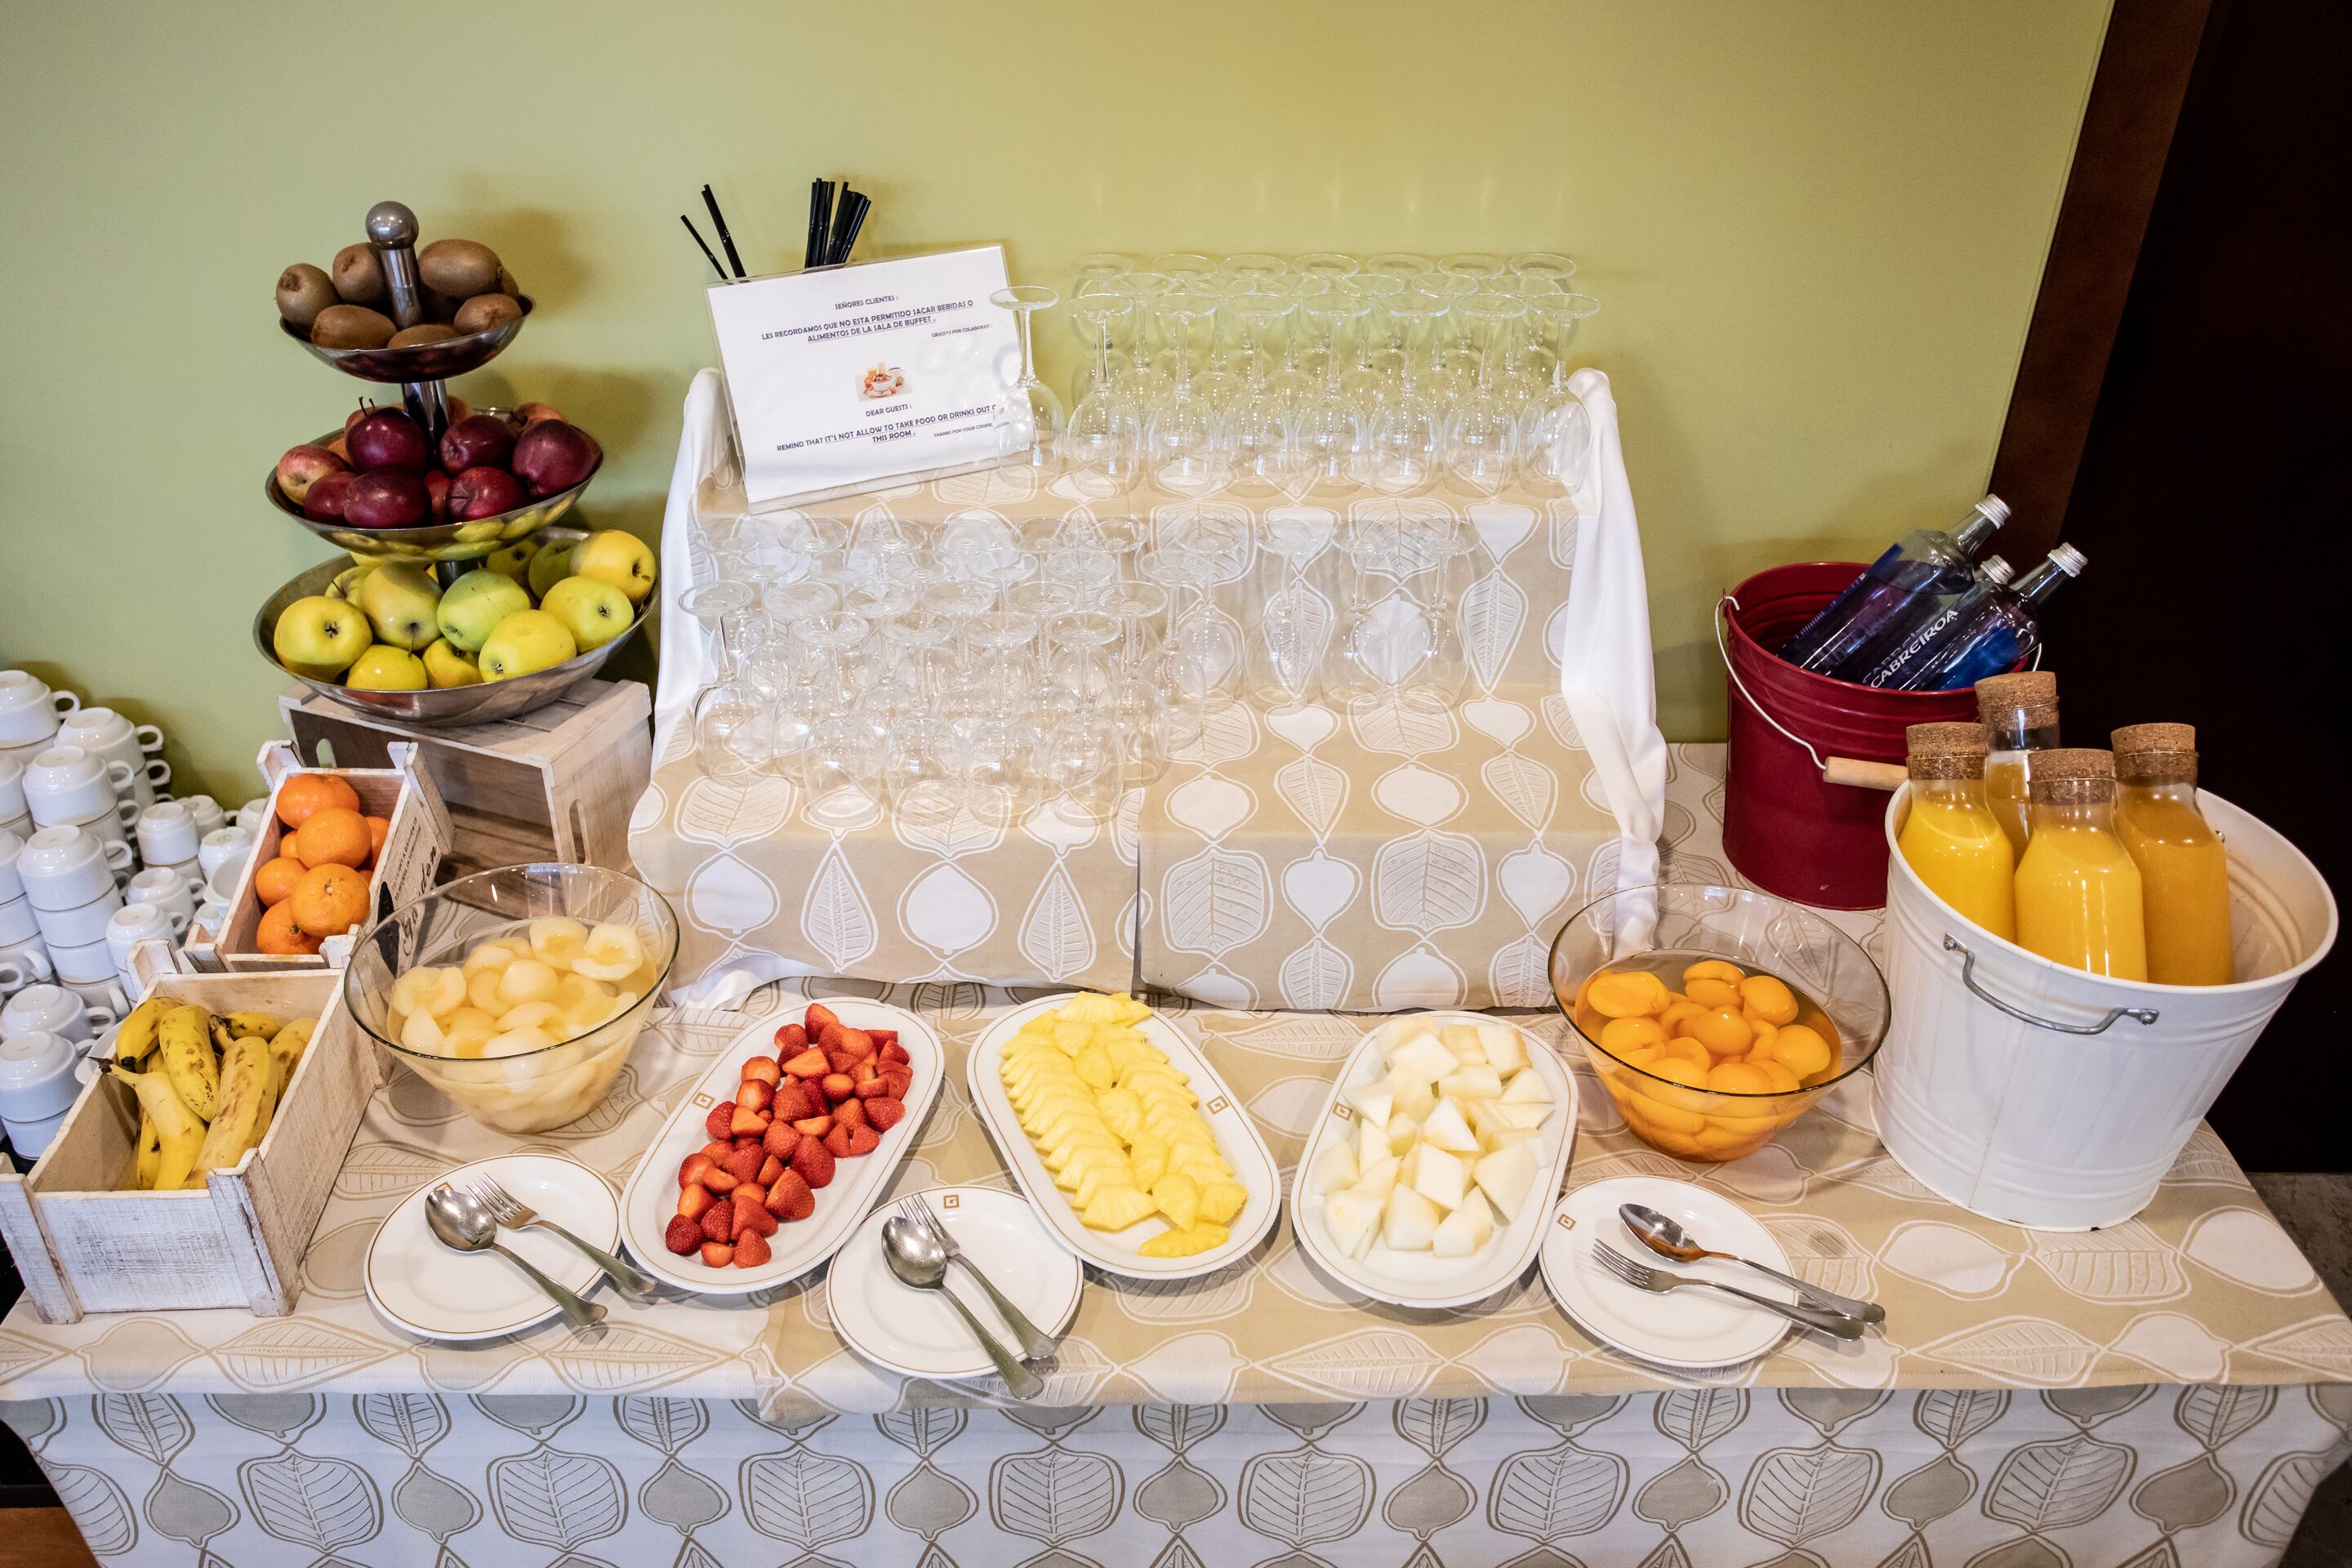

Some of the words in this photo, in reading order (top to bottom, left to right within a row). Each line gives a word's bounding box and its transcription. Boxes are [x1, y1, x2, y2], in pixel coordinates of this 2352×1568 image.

[835, 300, 864, 310] SEÑORES
[865, 295, 895, 305] CLIENTES
[761, 332, 773, 341] LES
[774, 325, 822, 338] RECORDAMOS
[823, 322, 838, 330] QUE
[839, 319, 851, 327] NO
[852, 316, 870, 325] ESTA
[871, 310, 911, 323] PERMITIDO
[912, 306, 936, 315] SACAR
[937, 301, 966, 312] BEBIDAS
[808, 329, 849, 342] ALIMENTOS
[851, 327, 862, 336] DE
[873, 323, 892, 332] SALA
[893, 320, 904, 328] DE
[866, 408, 884, 416] DEAR
[885, 403, 908, 413] GUESTS
[777, 441, 804, 452] REMIND
[805, 437, 823, 446] THAT
[825, 434, 837, 443] IT'S
[838, 430, 854, 440] NOT
[856, 425, 883, 436] ALLOW
[895, 420, 914, 430] TAKE
[915, 416, 936, 425] FOOD
[938, 413, 948, 421] OR
[949, 408, 975, 419] DRINKS
[976, 406, 991, 414] OUT
[872, 434, 888, 443] THIS
[889, 430, 911, 439] ROOM
